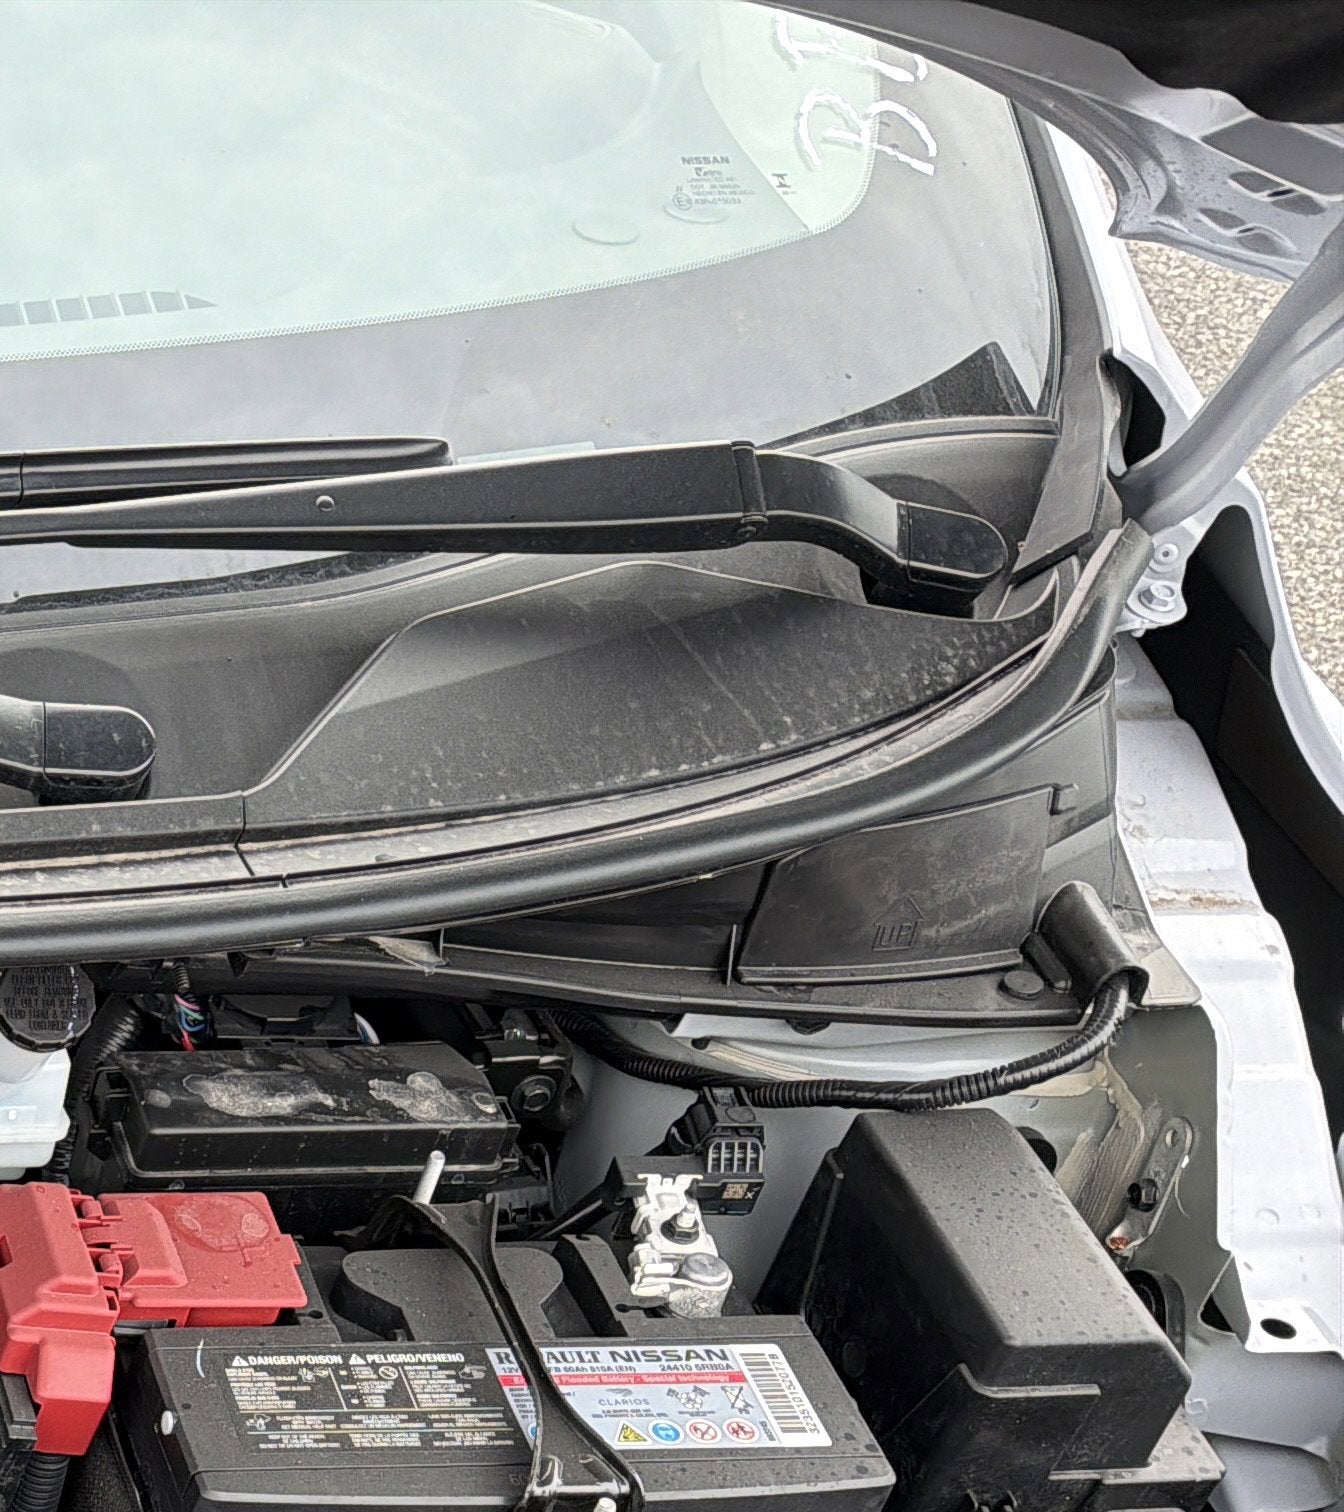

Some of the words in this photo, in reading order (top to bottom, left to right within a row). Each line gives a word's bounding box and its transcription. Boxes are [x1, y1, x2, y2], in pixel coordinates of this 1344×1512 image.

[681, 155, 730, 165] NISSAN
[247, 1354, 344, 1366] DANGER/POISON
[365, 1352, 466, 1365] PELIGRO/VENENO
[493, 1350, 602, 1365] RAULT
[608, 1348, 731, 1363] NISSAN
[598, 1397, 651, 1407] CLARIOS
